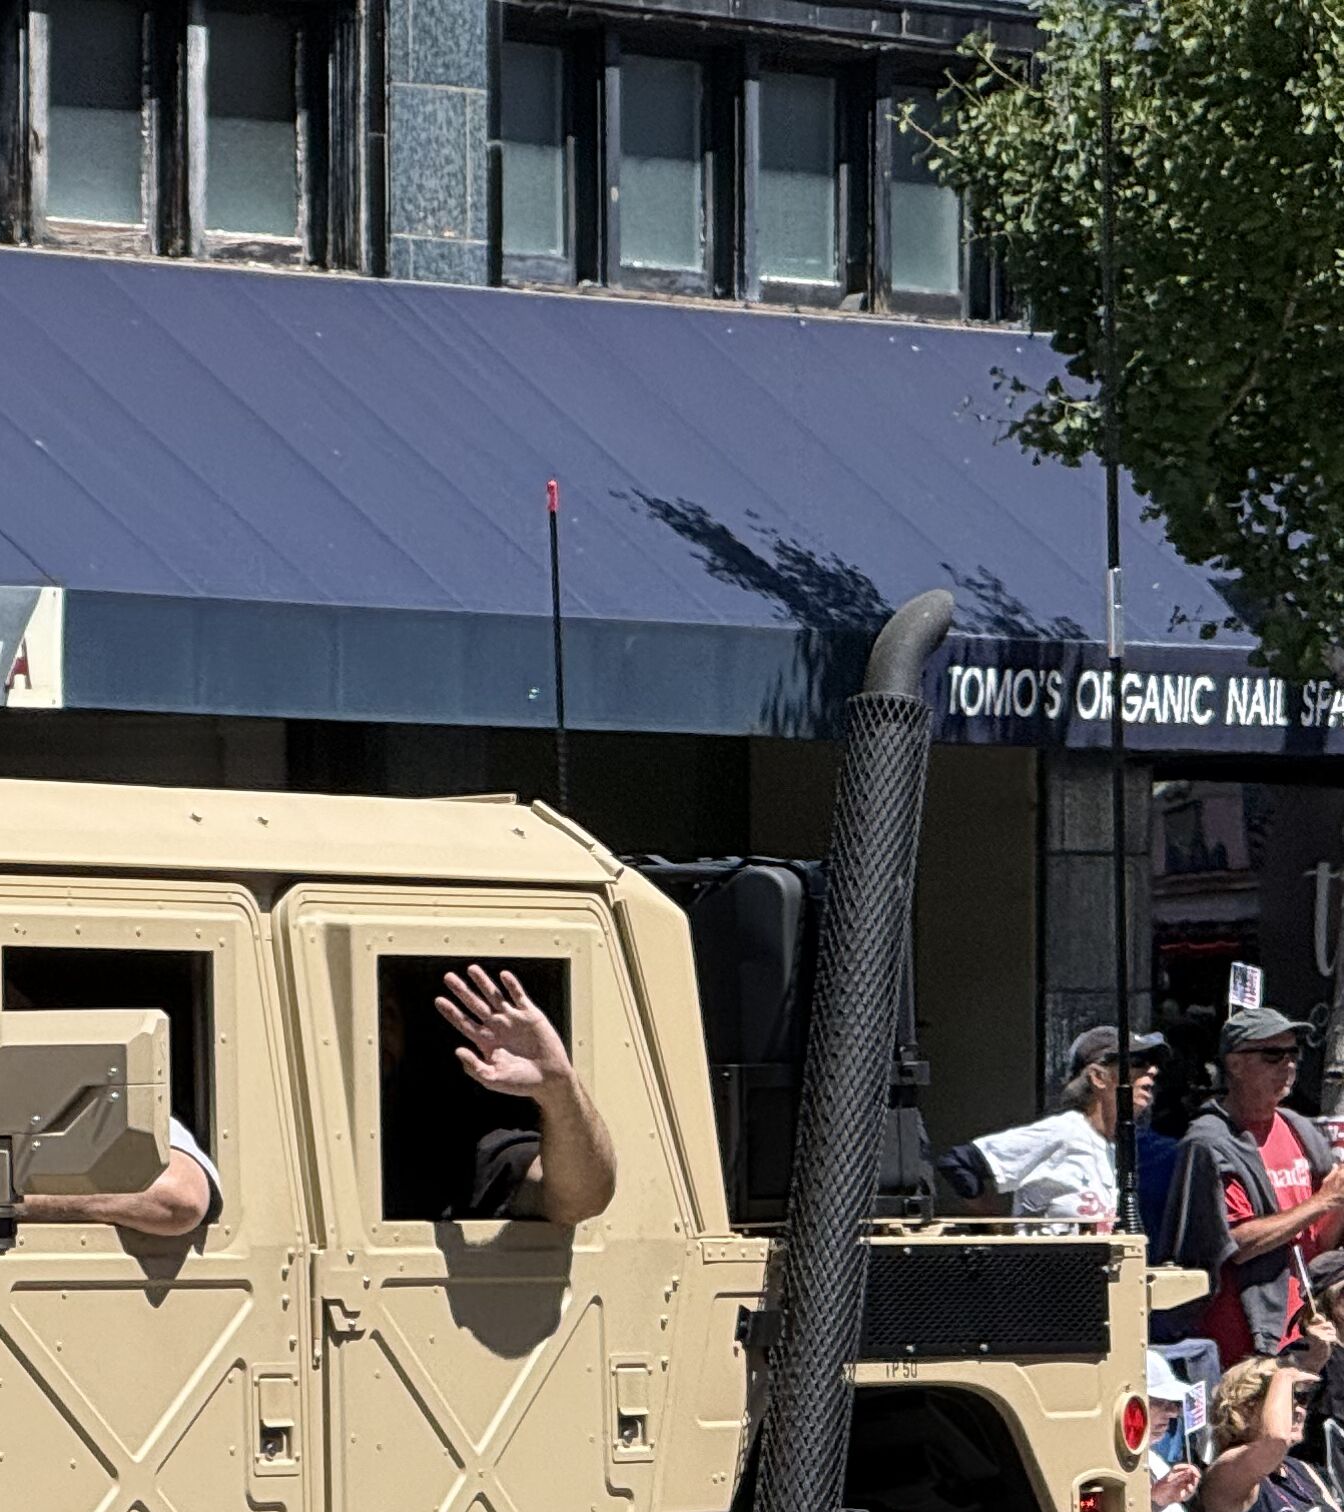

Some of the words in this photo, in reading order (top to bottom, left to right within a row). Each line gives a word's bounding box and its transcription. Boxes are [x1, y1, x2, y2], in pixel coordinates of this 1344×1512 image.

[948, 665, 1062, 720] TOMO'S
[1076, 669, 1216, 726] ORGANIC
[1226, 675, 1289, 728] NAIL
[902, 1357, 919, 1380] 50
